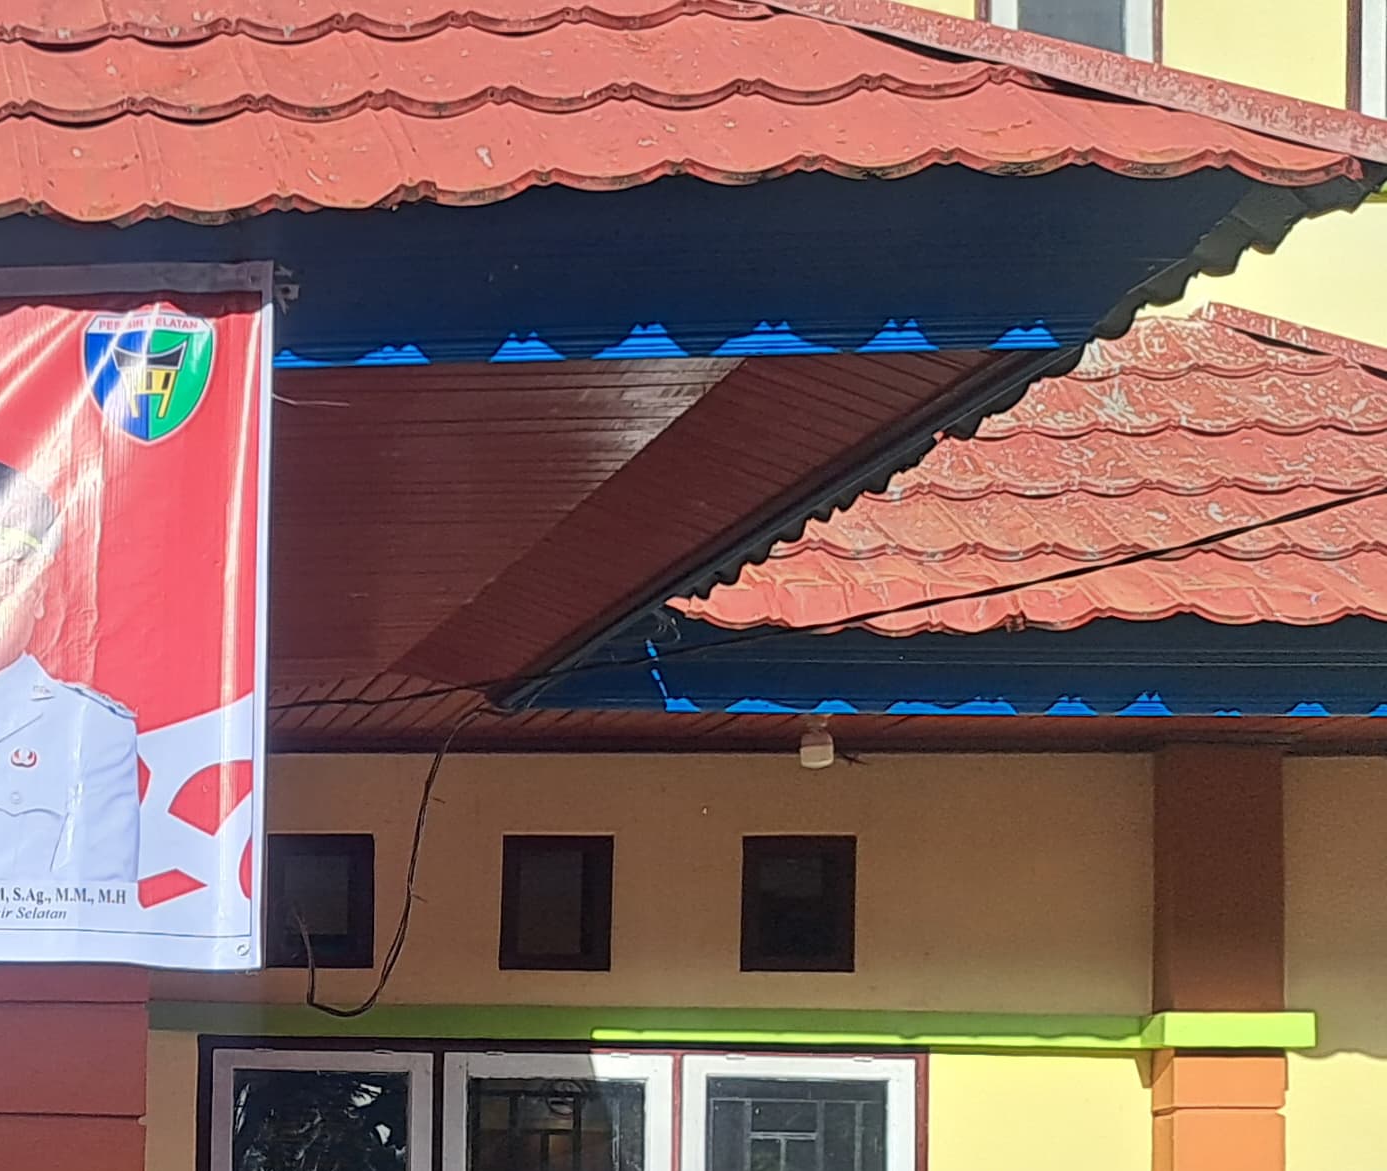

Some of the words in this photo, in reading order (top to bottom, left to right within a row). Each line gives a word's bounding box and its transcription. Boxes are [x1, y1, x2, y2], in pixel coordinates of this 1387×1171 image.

[146, 316, 199, 330] ELATAN
[12, 887, 51, 904] S.Ag.,
[98, 889, 127, 904] M.H
[16, 906, 67, 920] Selatan
